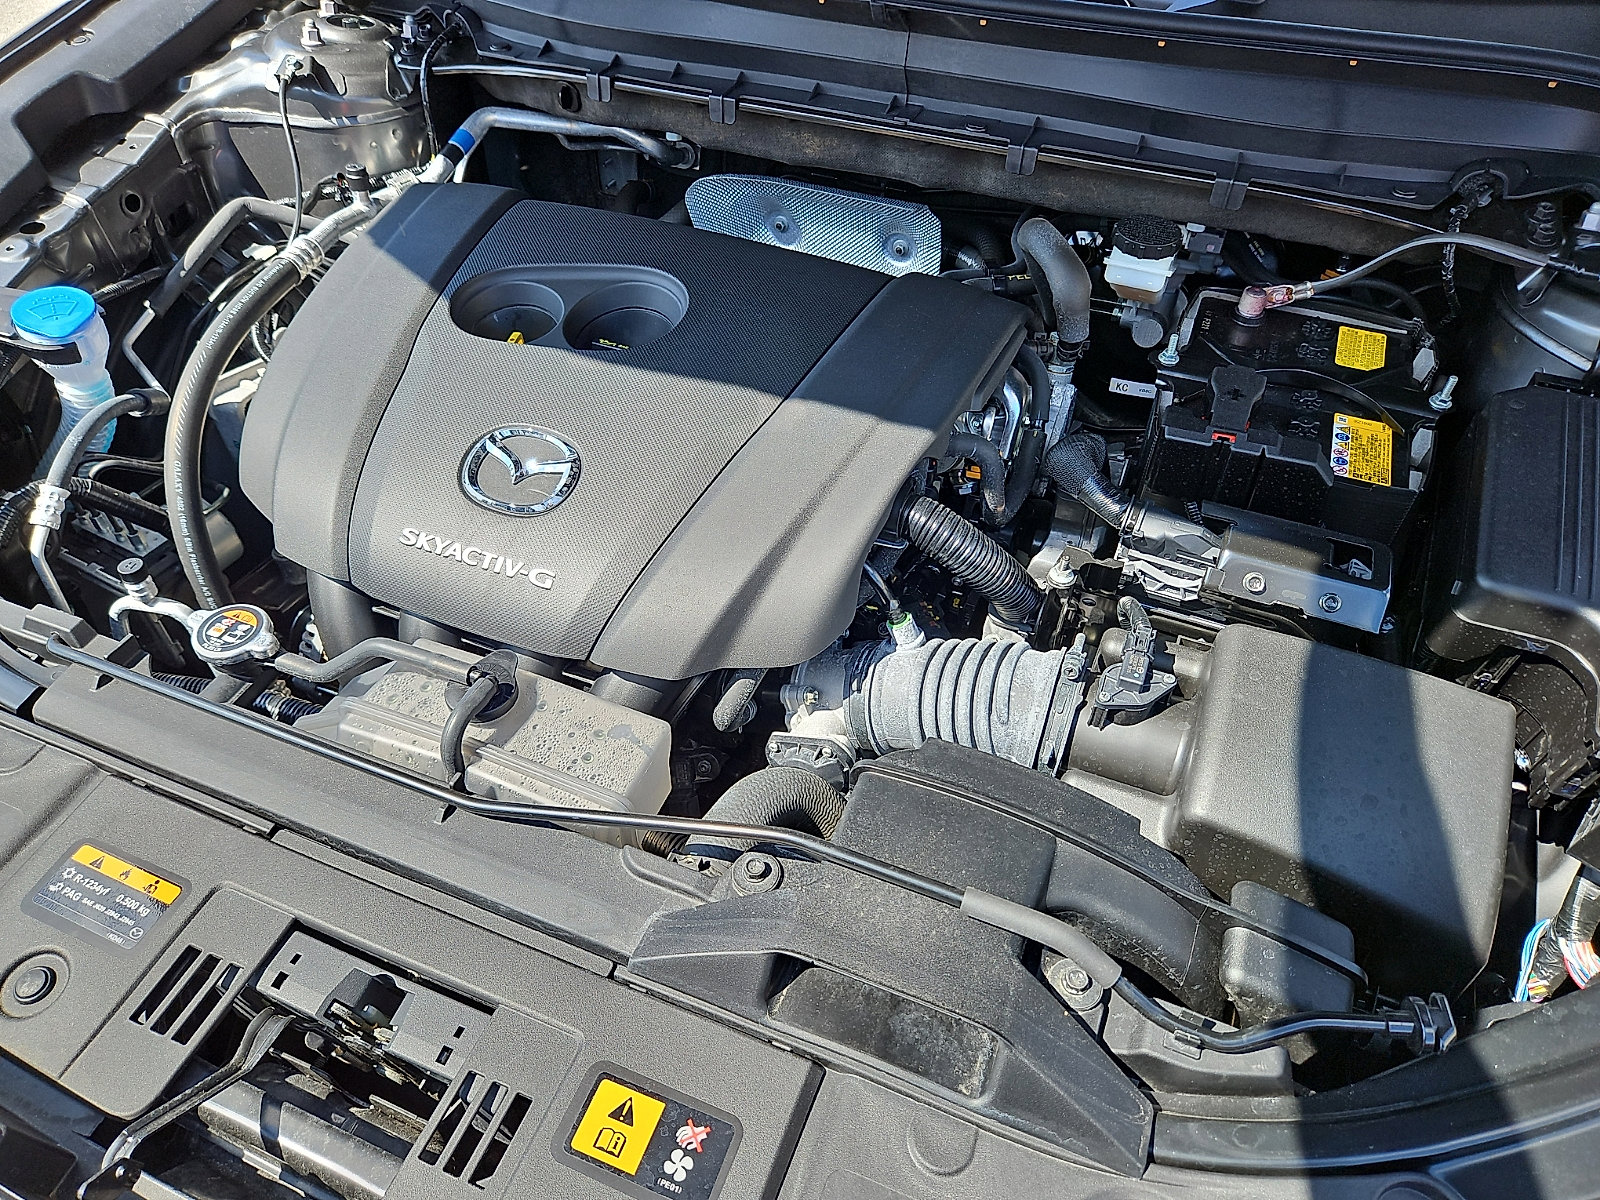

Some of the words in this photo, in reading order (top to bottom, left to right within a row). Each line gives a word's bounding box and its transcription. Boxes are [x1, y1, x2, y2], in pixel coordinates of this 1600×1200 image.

[1115, 382, 1129, 392] KC
[174, 461, 184, 495] GALAXY
[206, 597, 218, 610] SUC
[399, 527, 557, 590] SKYACTIV-G
[61, 887, 82, 901] PAG
[82, 897, 95, 908] SAE
[73, 873, 111, 897] R-1234yf
[116, 893, 139, 911] 0.500
[136, 905, 151, 918] kg
[657, 1177, 683, 1194] (PE01)
